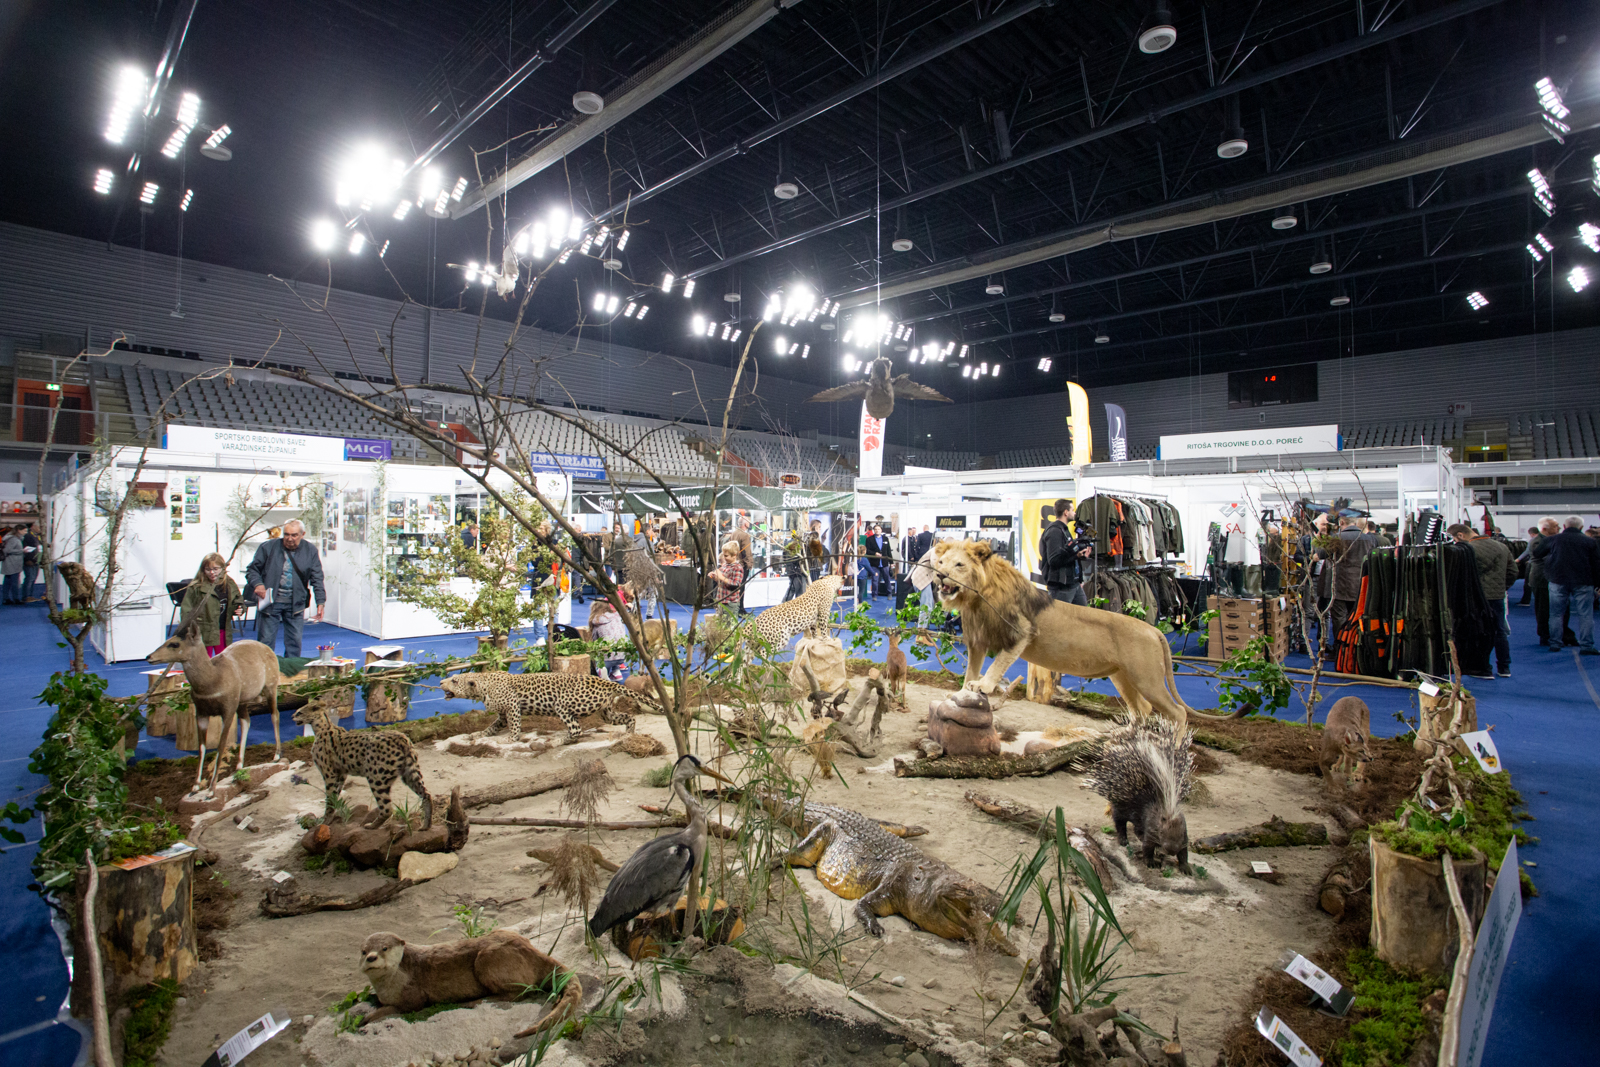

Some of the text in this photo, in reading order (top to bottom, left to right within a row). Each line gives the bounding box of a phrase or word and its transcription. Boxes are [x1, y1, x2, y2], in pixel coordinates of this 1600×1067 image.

[214, 433, 306, 446] SPORTSKO RIBOLOVNI SAVEZ
[1187, 442, 1212, 450] RITOŠA
[1213, 440, 1250, 448] TRGOVINE
[1276, 436, 1304, 445] POREČ
[221, 441, 297, 455] VARAŽDINSKE ŽUPANIJE
[781, 491, 818, 508] Kettner
[939, 517, 963, 526] Nikon
[983, 517, 1009, 526] Nikon
